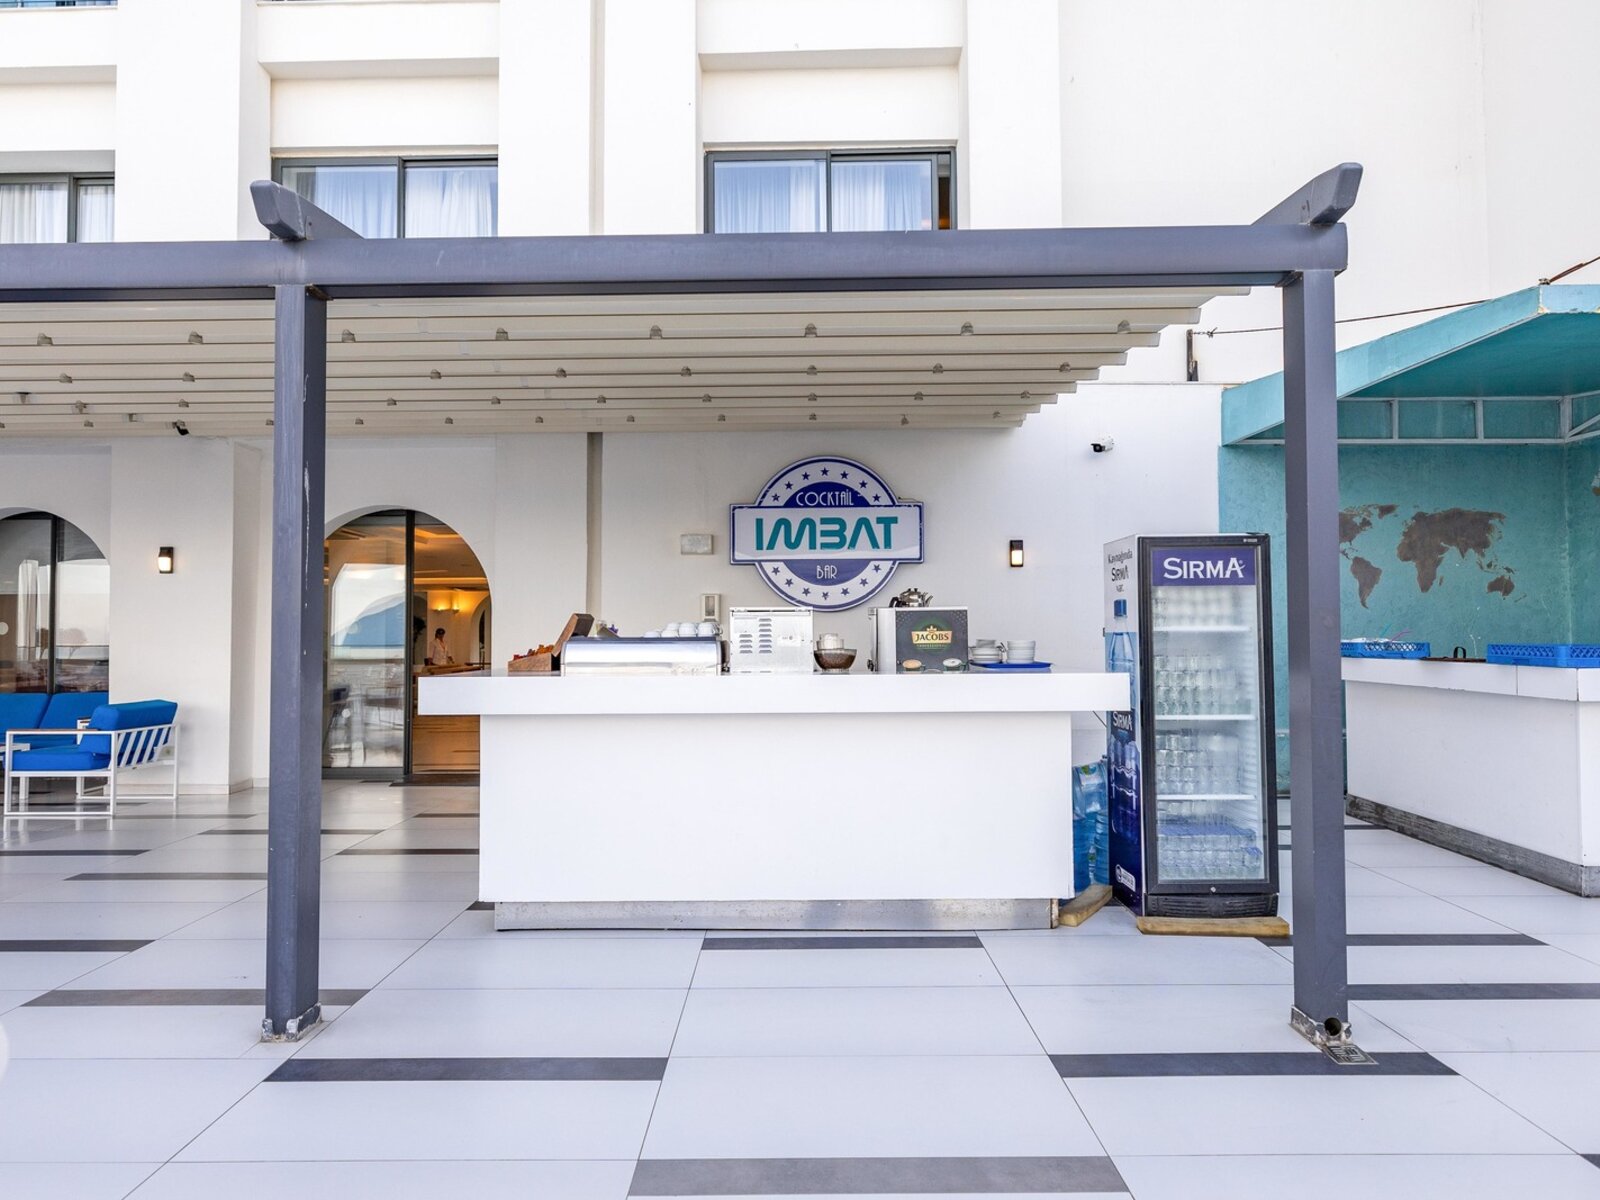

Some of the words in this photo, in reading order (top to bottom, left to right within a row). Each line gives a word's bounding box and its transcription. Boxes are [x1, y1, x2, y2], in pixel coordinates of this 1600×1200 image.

[755, 516, 898, 550] IMBAT
[816, 565, 837, 579] BAR
[1163, 557, 1245, 579] SIRMA
[914, 632, 949, 642] JACOBS
